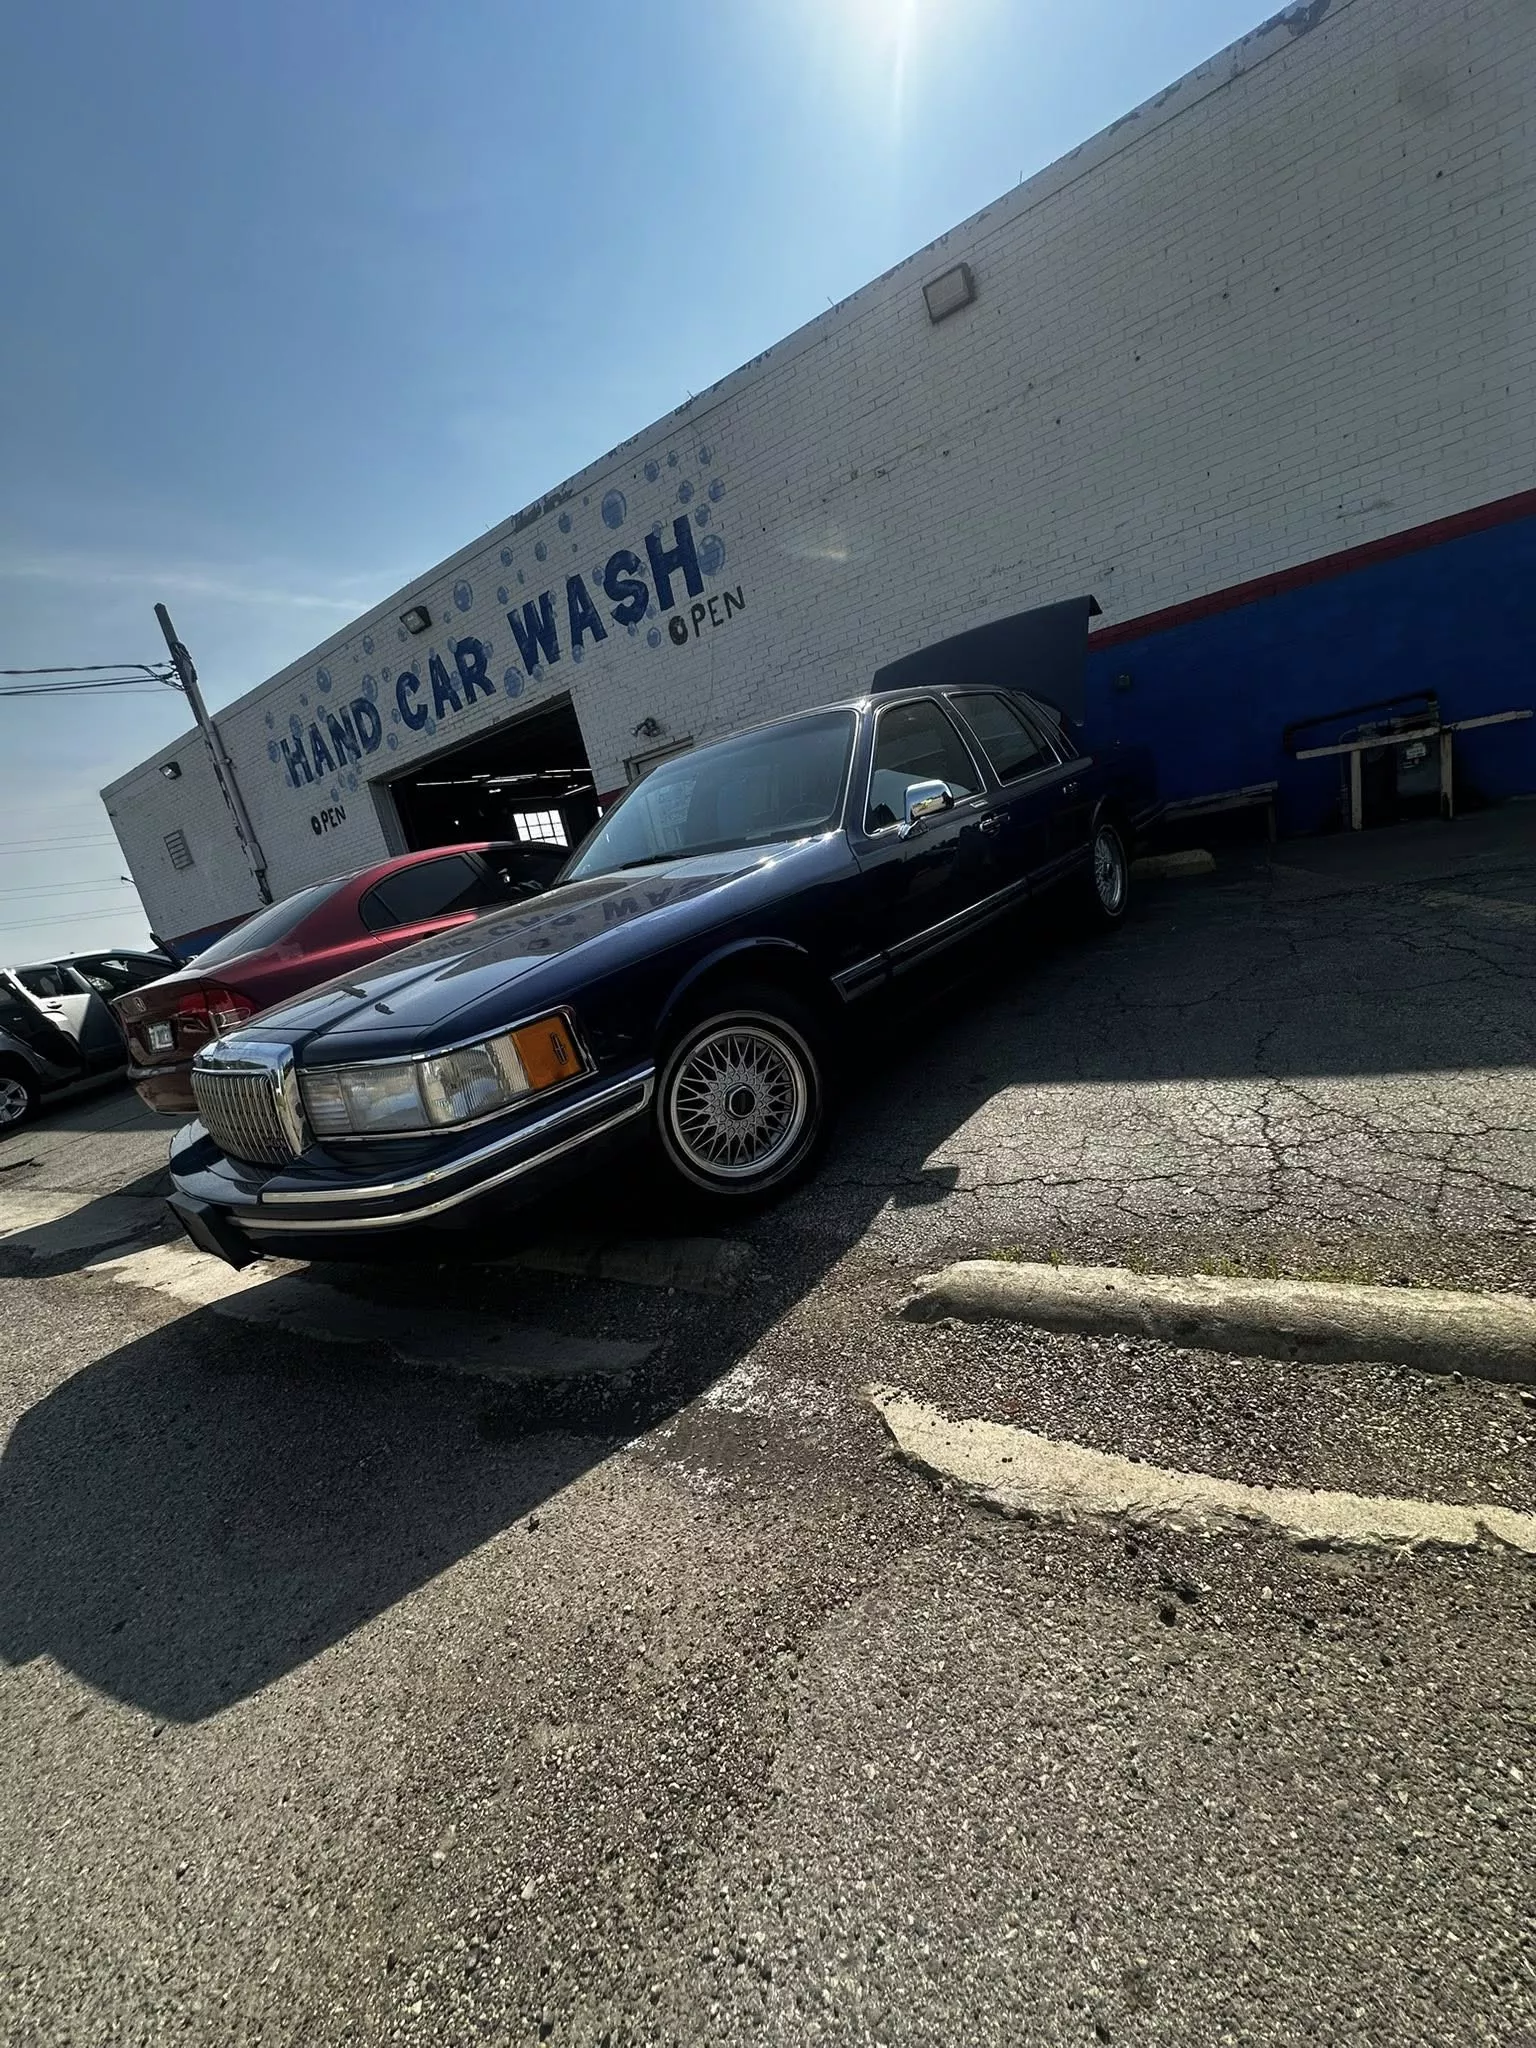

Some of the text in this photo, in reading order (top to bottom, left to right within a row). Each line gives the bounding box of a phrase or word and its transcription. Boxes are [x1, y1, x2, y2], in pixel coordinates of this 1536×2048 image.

[668, 585, 746, 646] OPEN
[280, 514, 704, 789] HAND CAR WASH
[311, 805, 347, 836] OPEN
